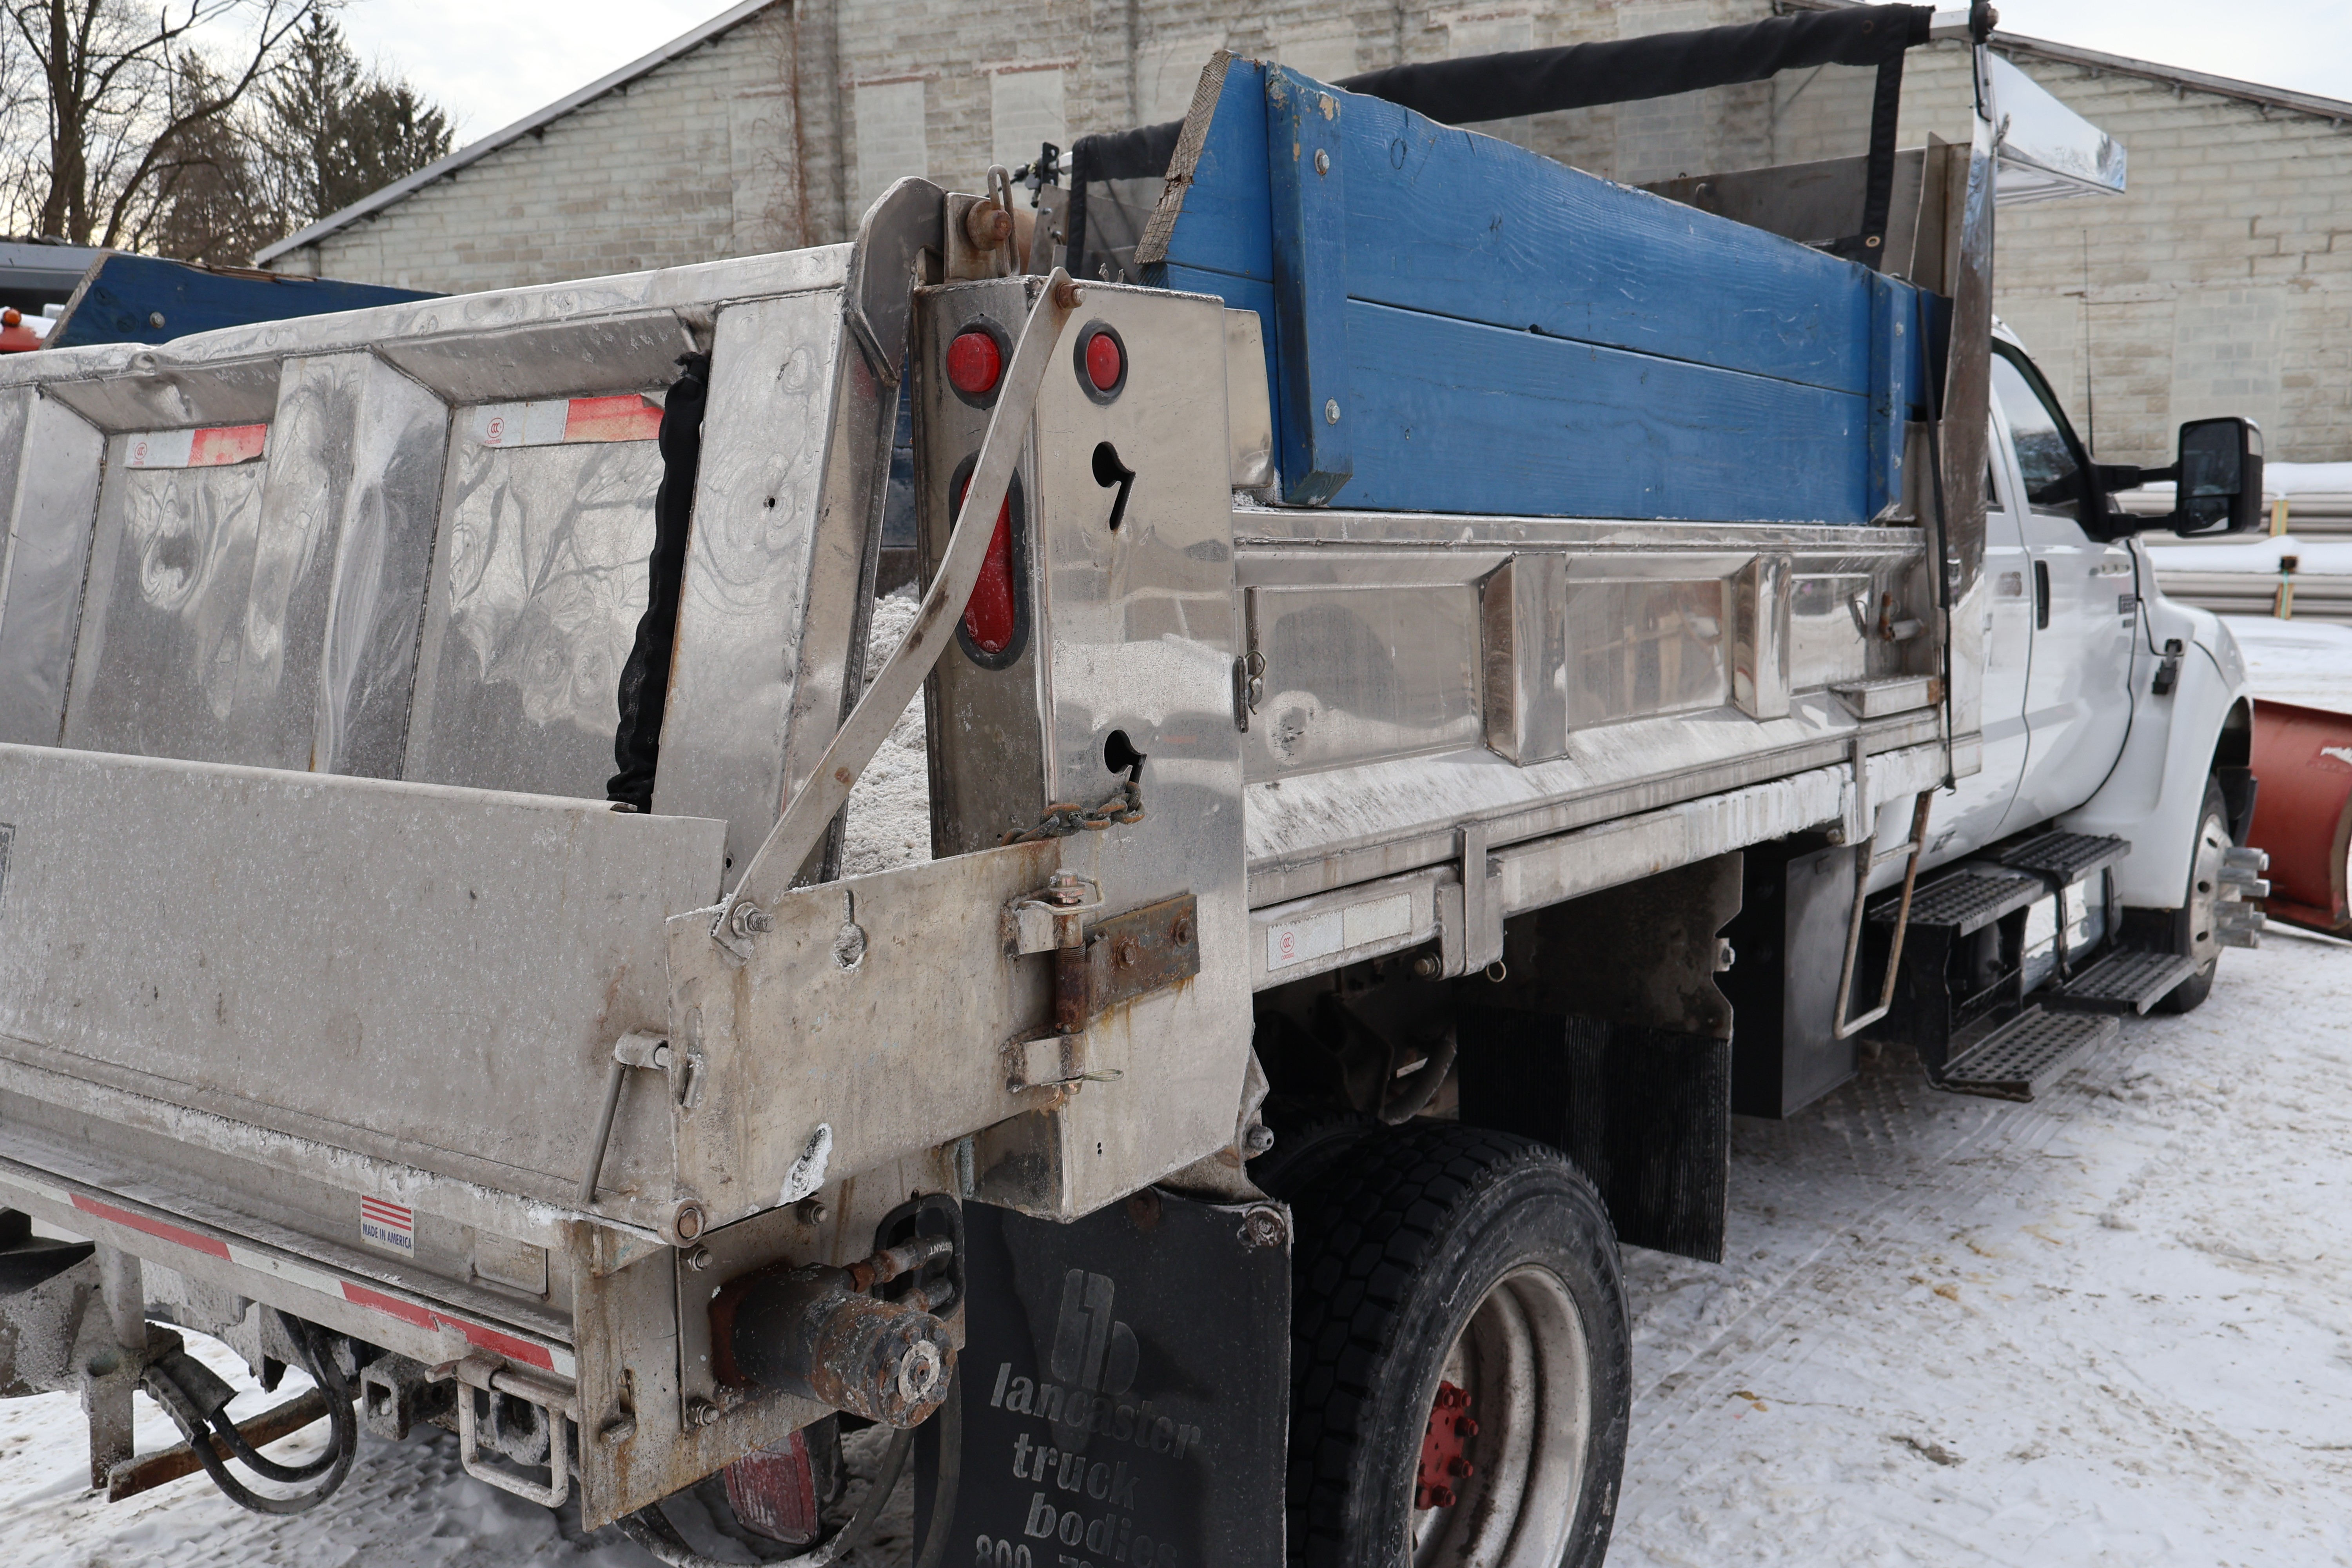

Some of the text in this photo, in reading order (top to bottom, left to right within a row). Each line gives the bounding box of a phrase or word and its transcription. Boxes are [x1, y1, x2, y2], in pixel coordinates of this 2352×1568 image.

[362, 1223, 412, 1250] MADE IN AMERICA
[990, 1362, 1201, 1460] lancaster
[1013, 1433, 1140, 1510] truck
[1024, 1492, 1178, 1568] bodies
